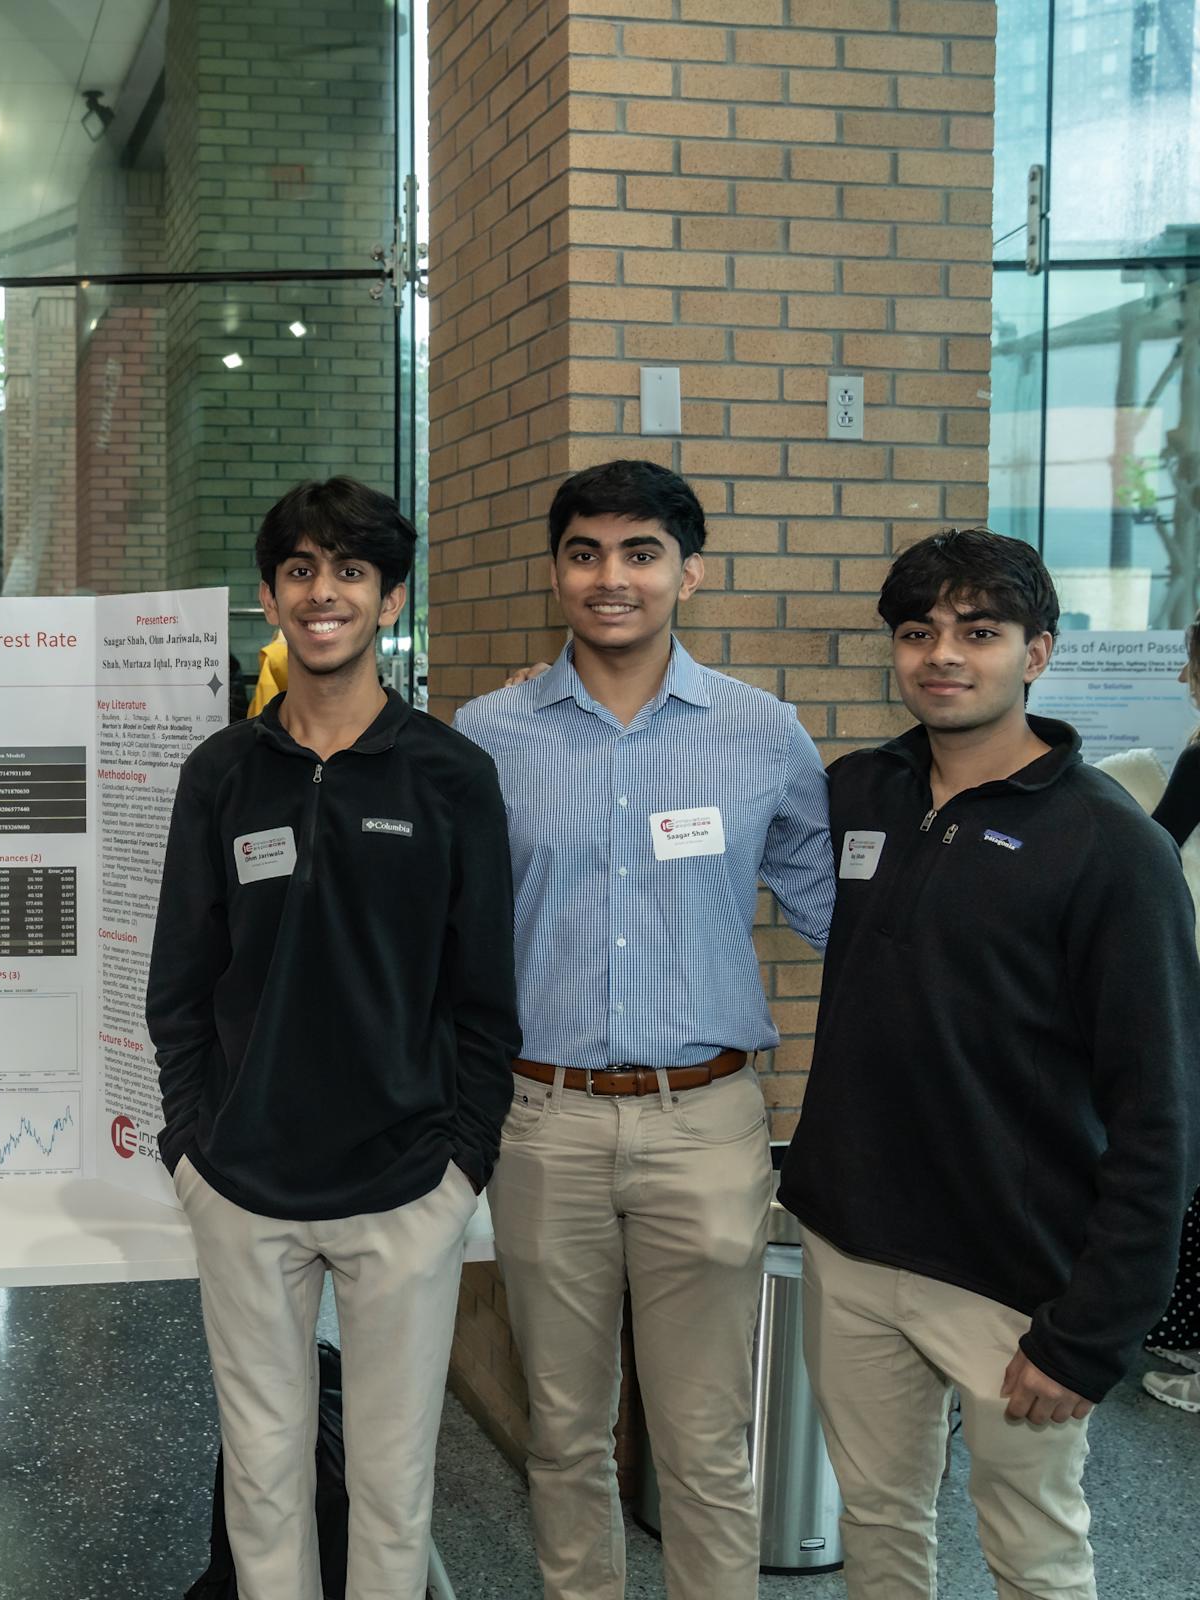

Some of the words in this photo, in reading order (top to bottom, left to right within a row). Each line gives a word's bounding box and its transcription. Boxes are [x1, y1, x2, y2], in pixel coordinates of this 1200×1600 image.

[136, 615, 179, 626] Presenters:
[37, 631, 78, 648] Rate
[103, 636, 126, 648] Saagar
[127, 635, 147, 645] Shah,
[149, 634, 164, 645] Ohm
[166, 633, 202, 644] Jariwala,
[203, 632, 218, 645] Raj
[1053, 643, 1078, 656] ysis
[1081, 642, 1095, 655] of
[1098, 641, 1144, 655] Airport
[1147, 642, 1188, 654] Passe
[102, 659, 121, 669] Shah,
[122, 659, 152, 669] Murtaza
[153, 658, 173, 670] Iqbal,
[175, 657, 202, 669] Prayag
[204, 657, 219, 667] Rao
[97, 700, 110, 711] Key
[111, 700, 147, 710] Literature
[97, 769, 147, 783] Methodology
[374, 820, 411, 833] Columbia
[666, 832, 691, 841] Saagar
[691, 829, 709, 837] Shah
[30, 853, 42, 864] (2)
[258, 849, 284, 860] Jariwala
[98, 927, 138, 943] Conclusion
[9, 971, 21, 981] (3)
[98, 1031, 122, 1046] Future
[123, 1037, 144, 1052] Steps
